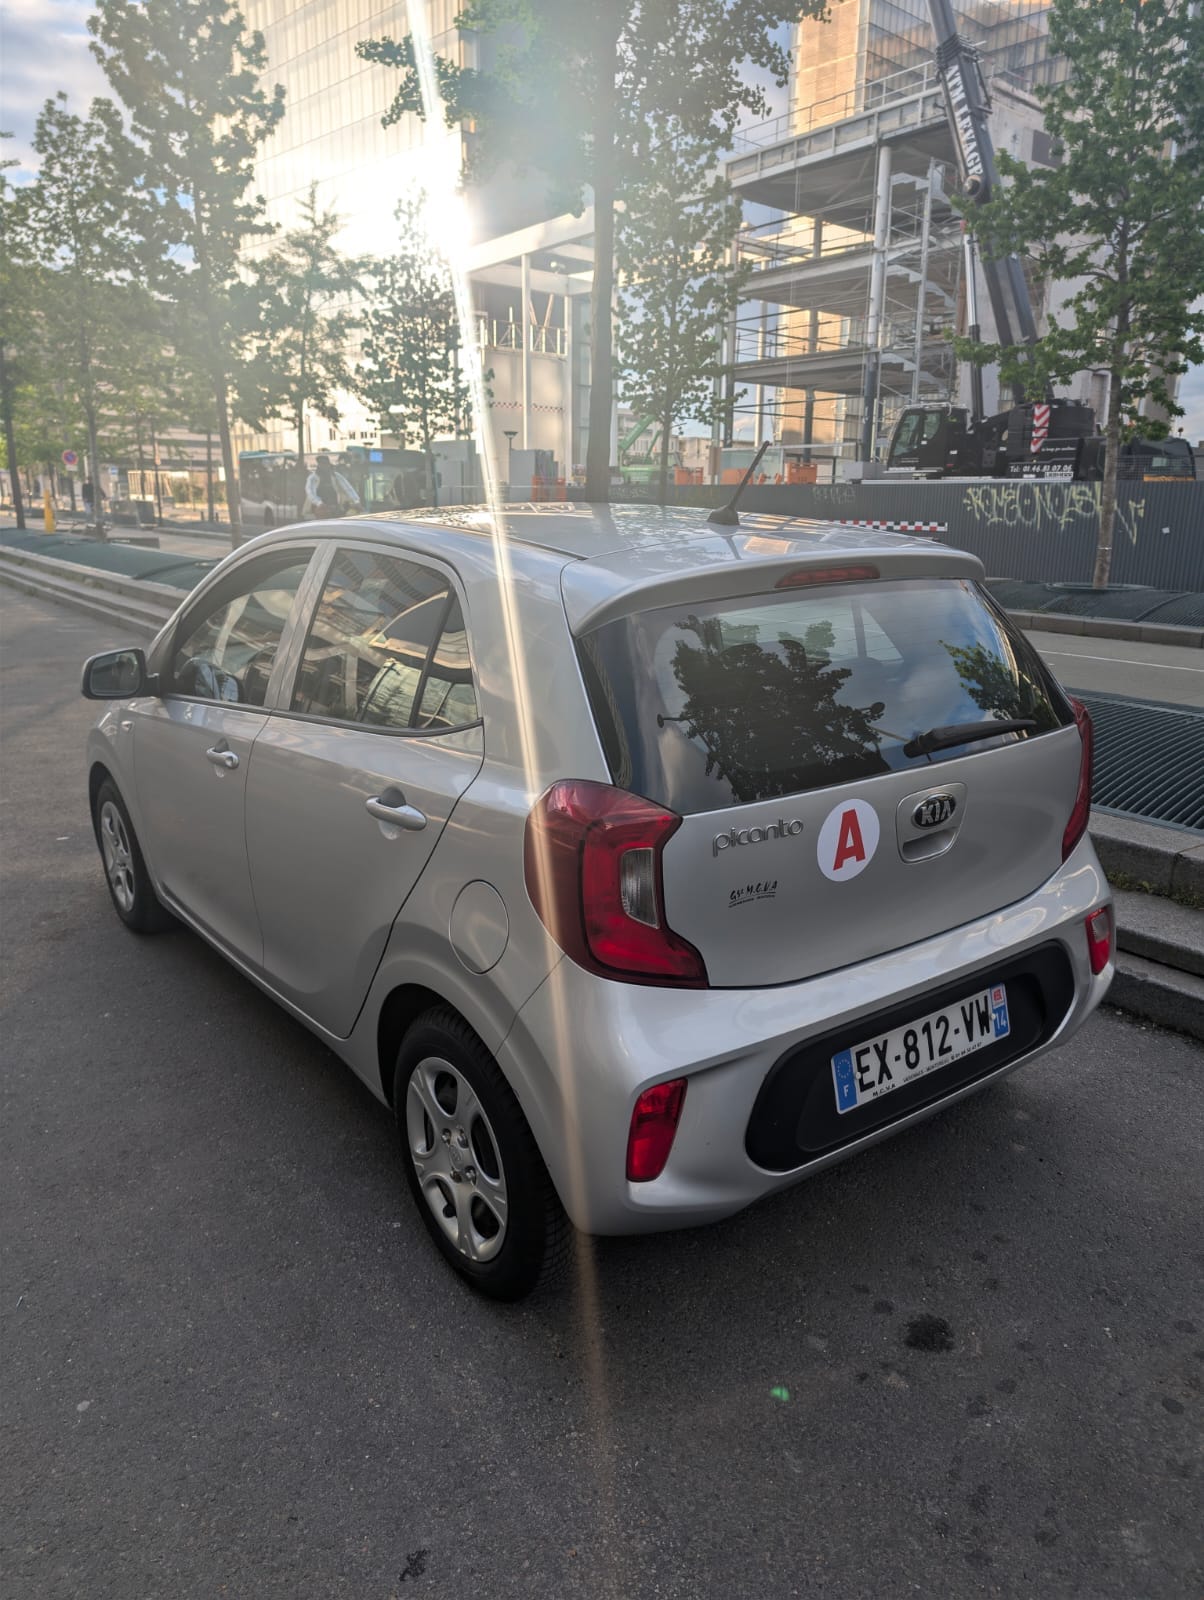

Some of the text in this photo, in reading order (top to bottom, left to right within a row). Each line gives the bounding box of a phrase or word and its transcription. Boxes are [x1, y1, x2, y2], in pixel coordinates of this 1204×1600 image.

[712, 818, 804, 857] picanto
[920, 800, 951, 825] KIA
[832, 808, 866, 871] A
[843, 1084, 850, 1098] F
[855, 995, 990, 1093] EX-812-VW
[995, 1012, 1007, 1030] 14
